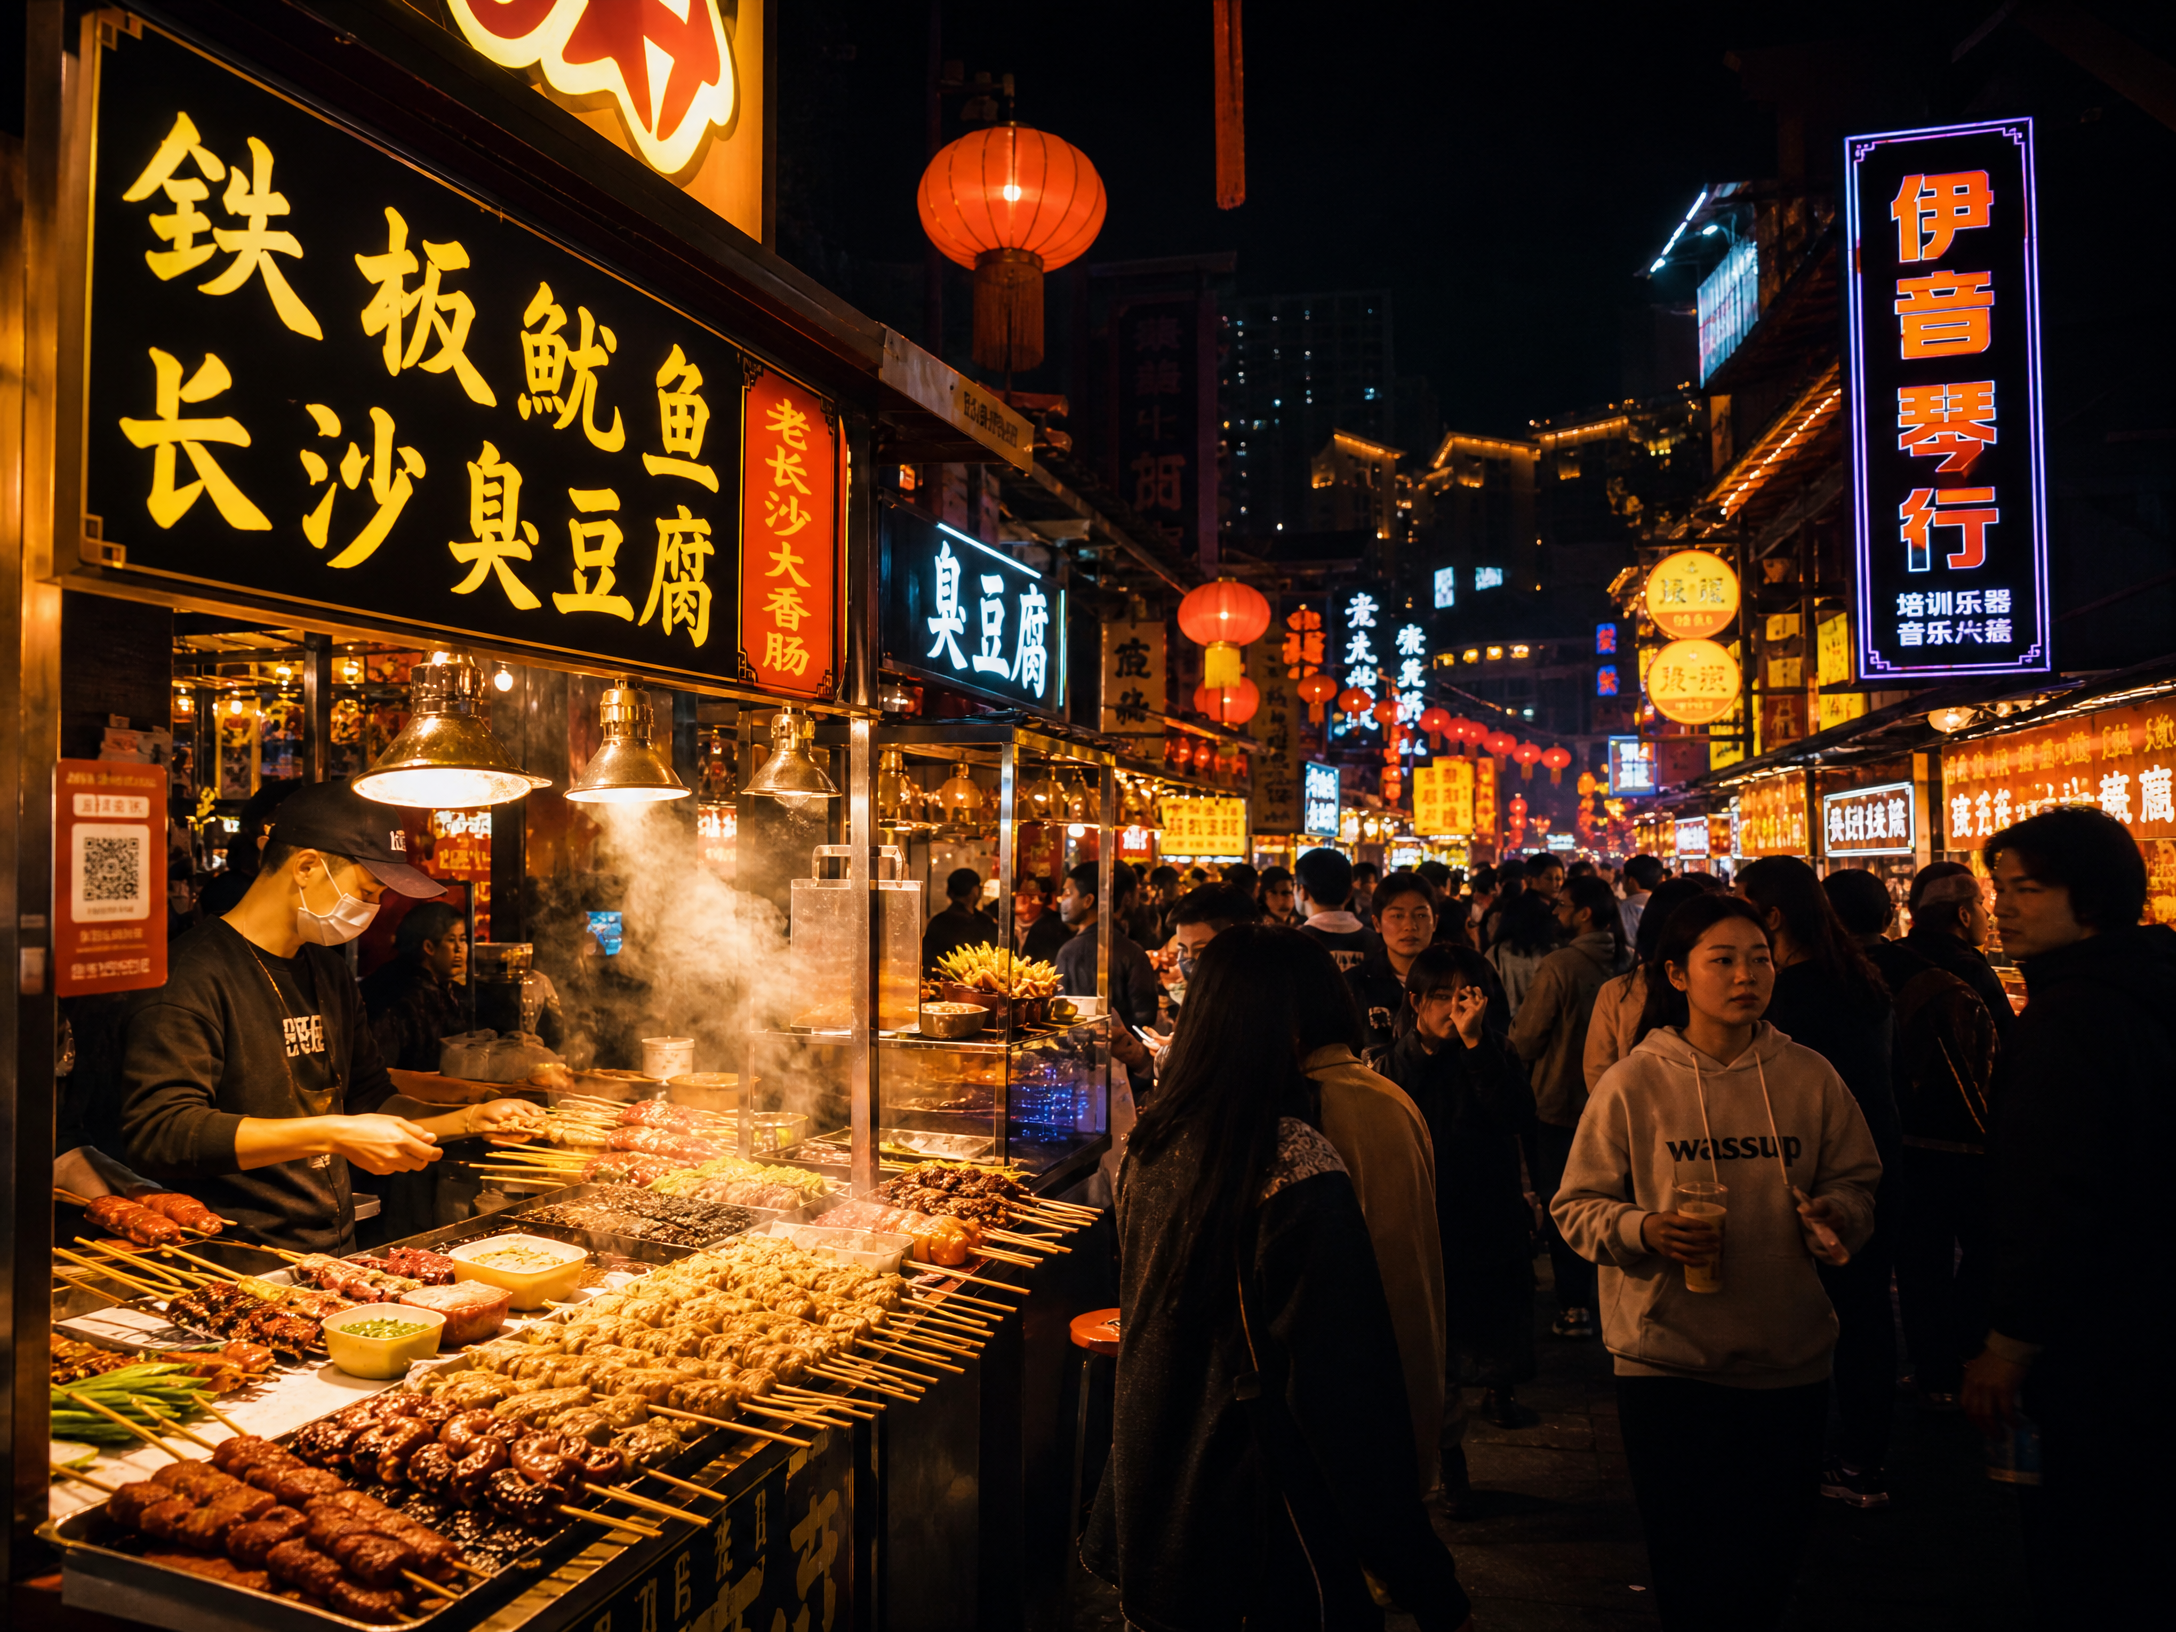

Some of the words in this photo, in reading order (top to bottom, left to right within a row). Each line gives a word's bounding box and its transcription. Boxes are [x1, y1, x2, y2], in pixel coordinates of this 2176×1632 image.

[1890, 169, 2000, 573] 伊音琴行
[119, 346, 715, 648] 长沙臭豆腐
[762, 398, 812, 677] 老长沙大香肠
[1896, 589, 2012, 617] 培训乐器
[926, 540, 1049, 699] 臭豆腐
[1666, 1136, 1802, 1167] wassup
